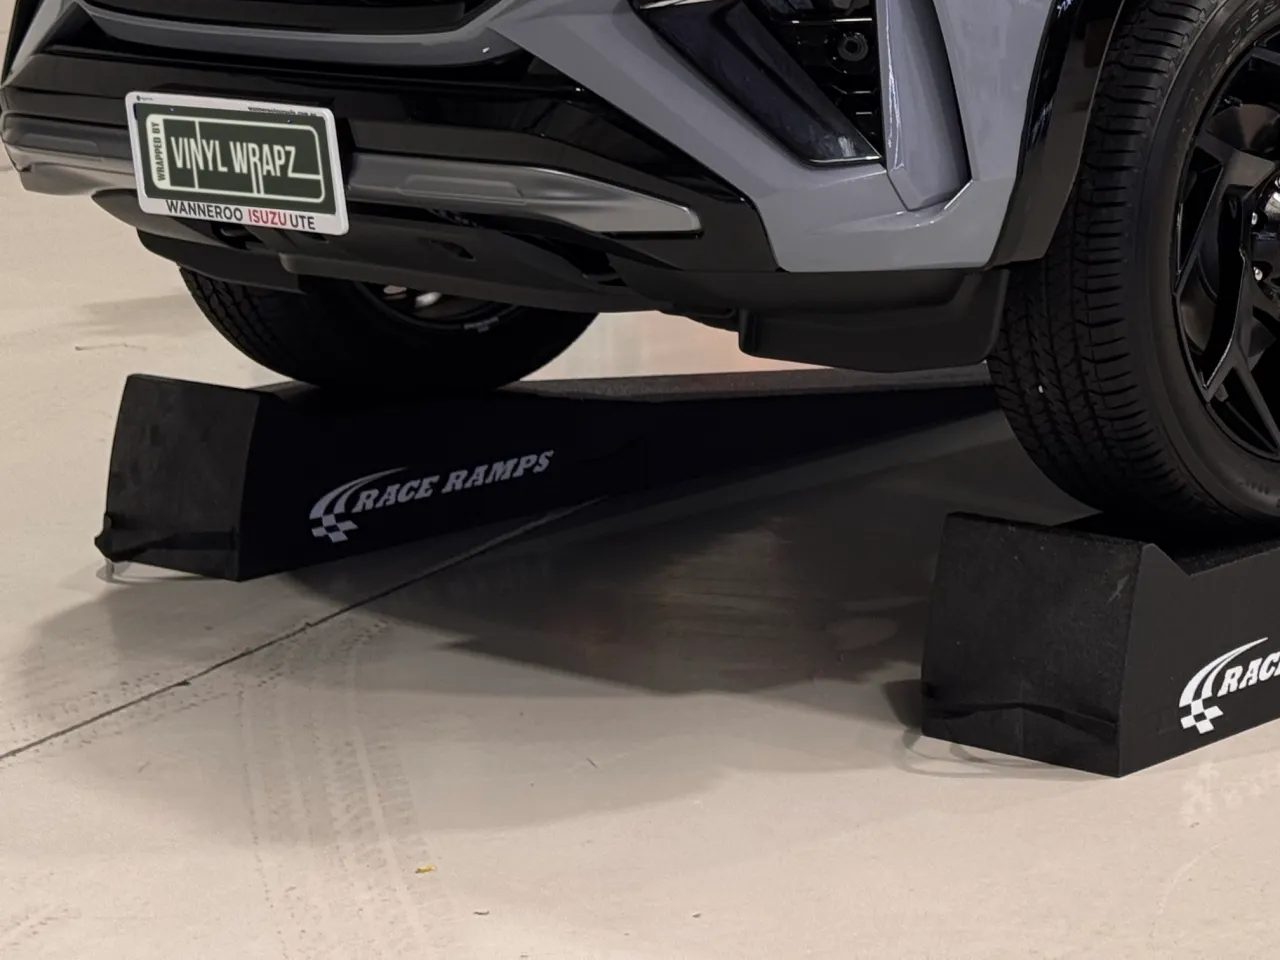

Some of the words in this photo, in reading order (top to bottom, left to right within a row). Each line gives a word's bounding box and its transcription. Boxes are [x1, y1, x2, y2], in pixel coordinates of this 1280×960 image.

[151, 121, 162, 135] BY
[151, 136, 168, 182] WRAPPED
[169, 136, 229, 174] VINYL
[228, 140, 297, 178] WRAPZ
[166, 199, 244, 223] WANNEROO
[247, 208, 288, 227] ISUZU
[289, 214, 317, 231] UTE
[351, 473, 441, 514] RACE
[440, 448, 555, 495] RAMPS
